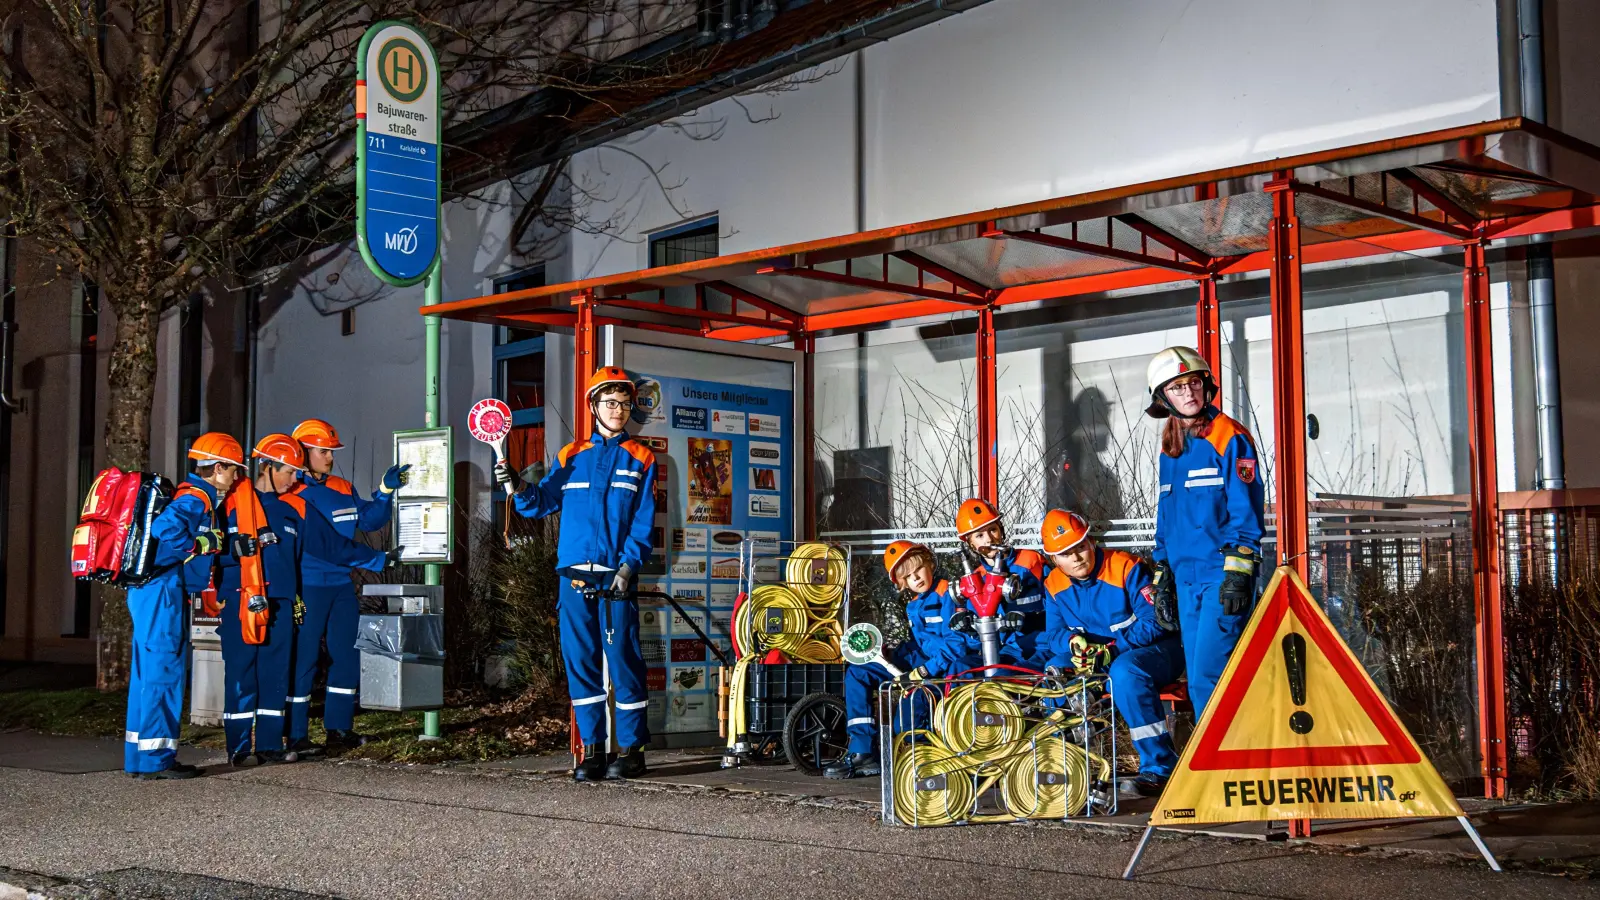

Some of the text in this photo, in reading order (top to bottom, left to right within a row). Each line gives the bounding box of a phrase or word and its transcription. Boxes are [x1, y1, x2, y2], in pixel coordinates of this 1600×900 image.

[377, 103, 428, 122] Bajuwaren-
[388, 123, 417, 137] straße
[368, 136, 386, 150] 711
[682, 387, 718, 401] Unsere
[472, 399, 499, 416] HALT
[675, 408, 697, 418] Allianz
[471, 416, 512, 442] FEUERWEHR
[672, 565, 698, 574] Karlsfeld
[676, 589, 702, 598] KURIER
[1223, 774, 1396, 808] FEUERWEHR
[1399, 790, 1416, 803] gfd
